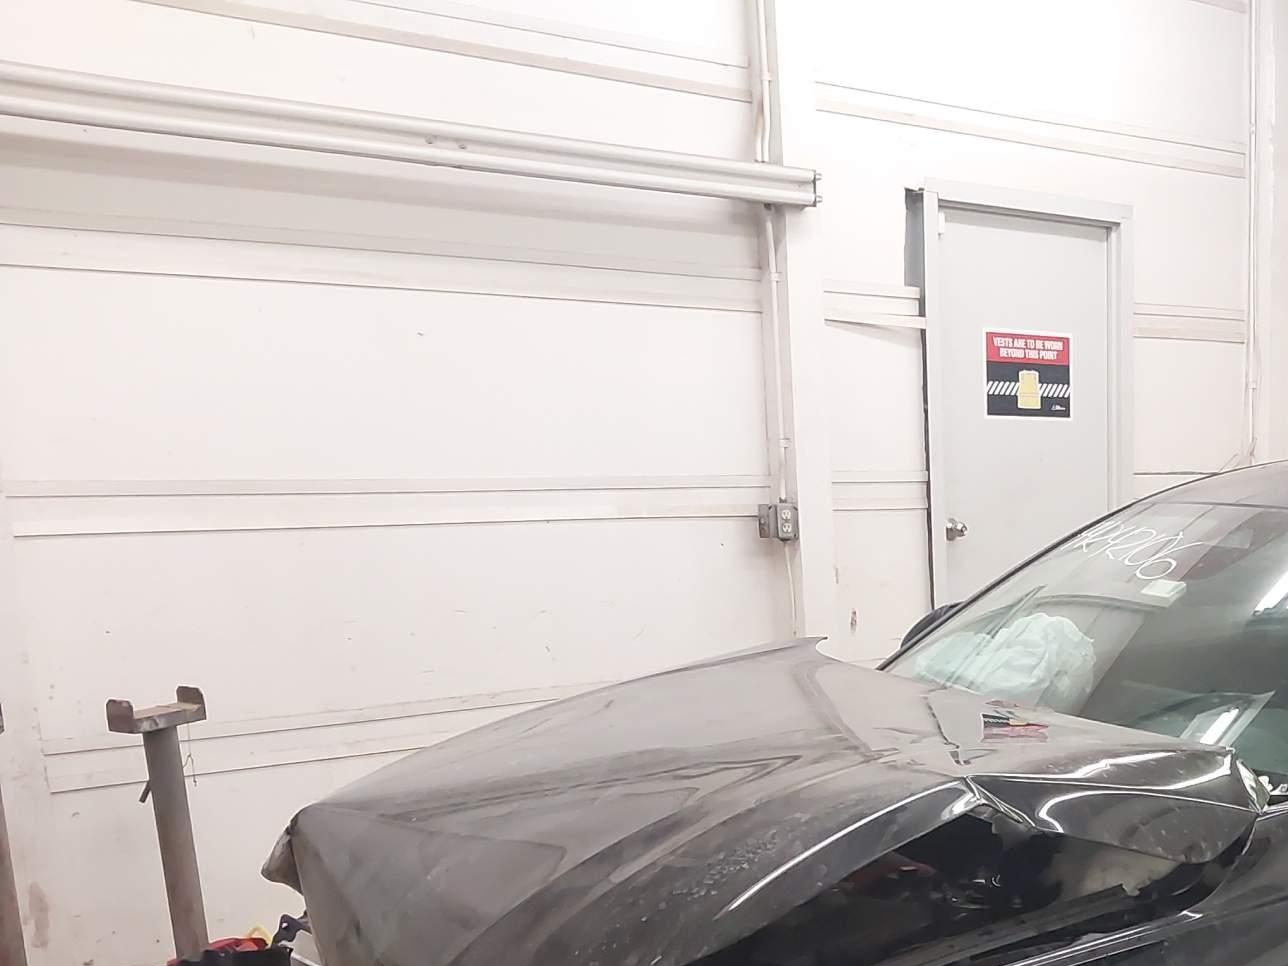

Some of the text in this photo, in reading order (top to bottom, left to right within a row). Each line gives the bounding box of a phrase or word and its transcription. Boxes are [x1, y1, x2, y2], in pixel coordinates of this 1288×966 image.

[993, 336, 1064, 351] VESTS ARE TO BE WORN
[1000, 347, 1057, 360] BEYOND THIS POINT
